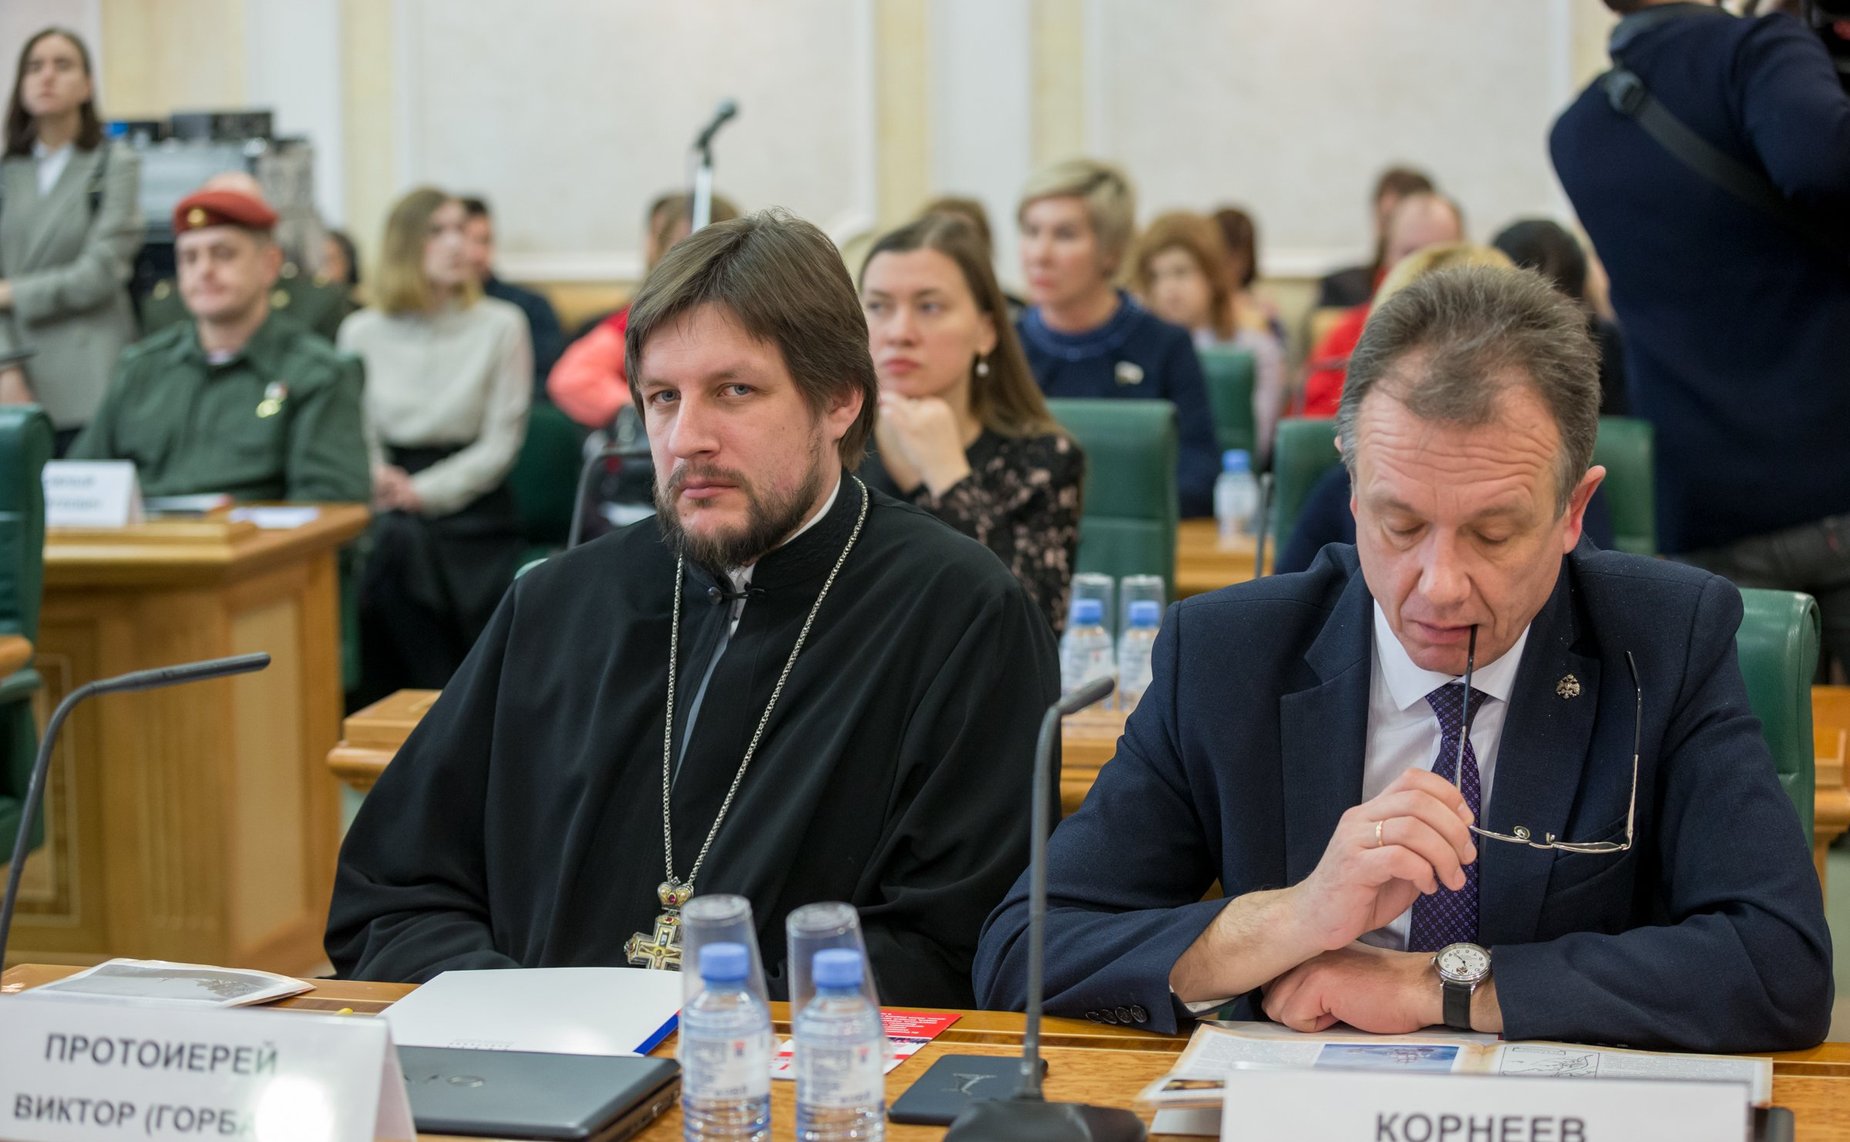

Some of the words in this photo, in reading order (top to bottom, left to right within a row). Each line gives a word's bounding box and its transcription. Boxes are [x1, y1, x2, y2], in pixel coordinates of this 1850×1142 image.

[44, 1033, 279, 1075] ПРОТОИЕРЕЙ
[13, 1093, 137, 1127] ВИКТОР
[1376, 1112, 1586, 1142] КОРНЕЕВ
